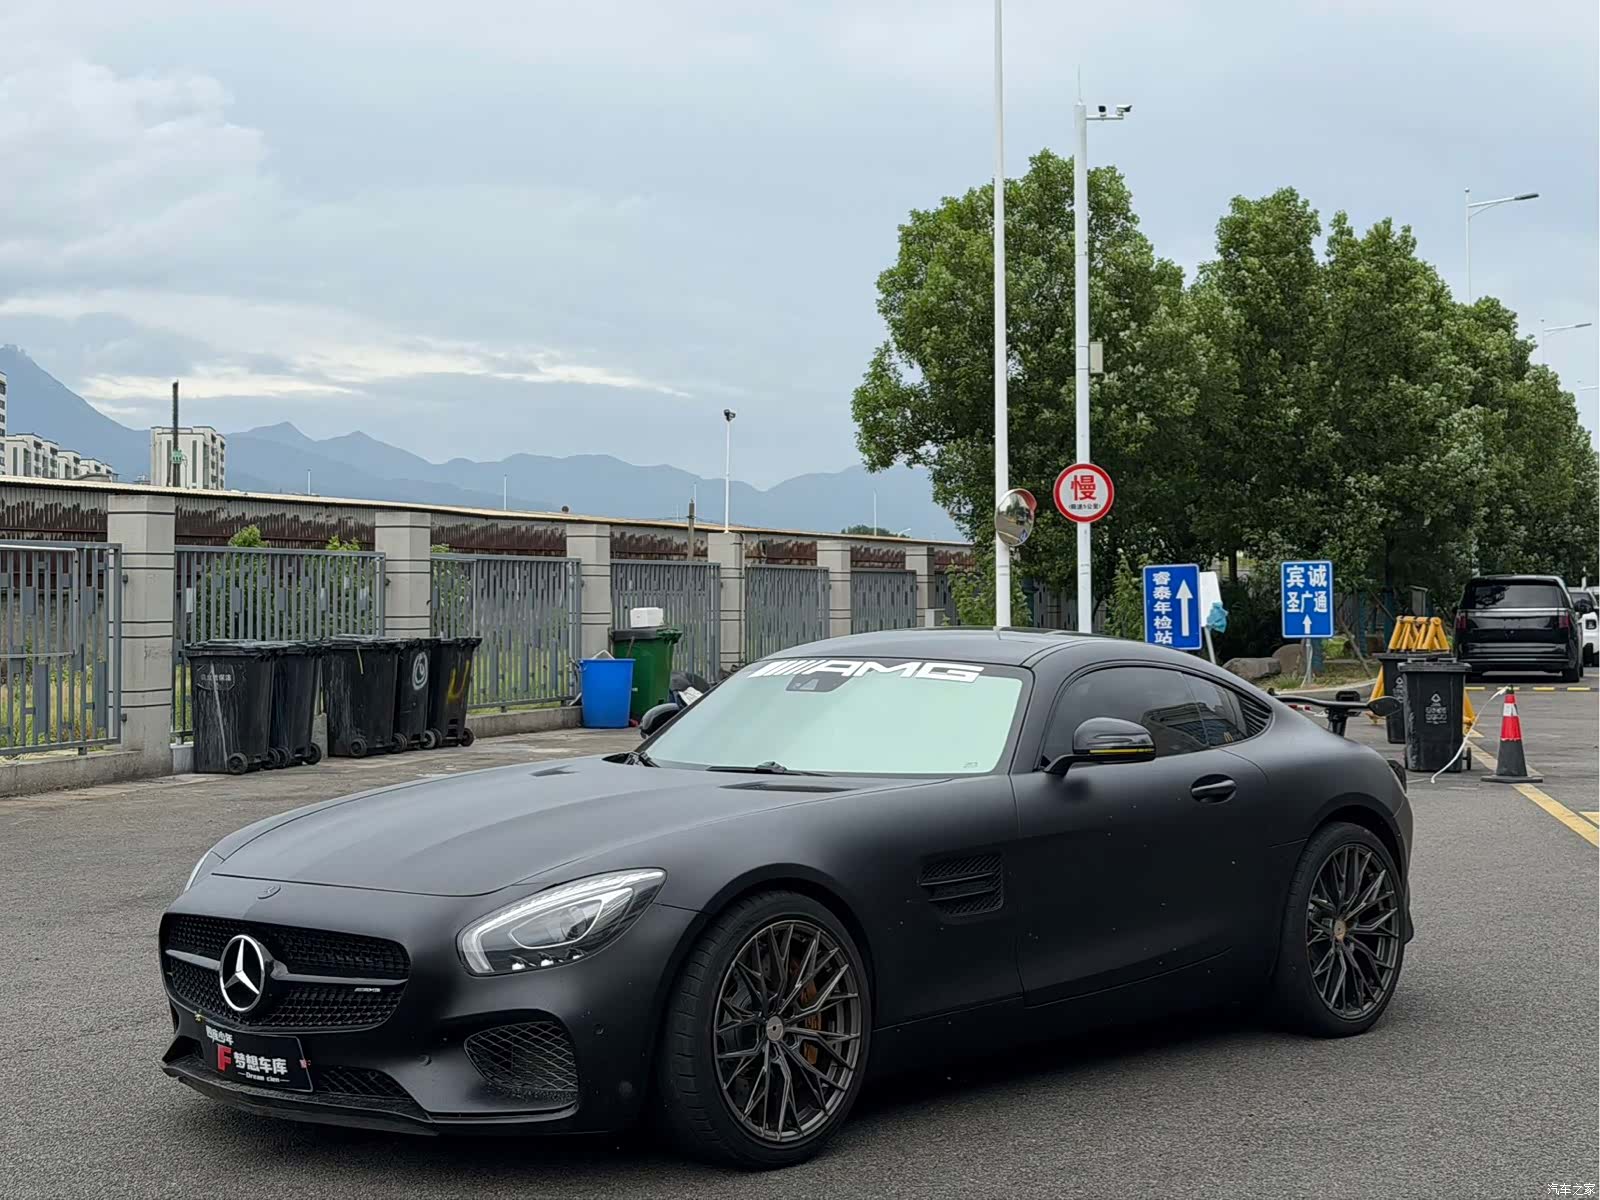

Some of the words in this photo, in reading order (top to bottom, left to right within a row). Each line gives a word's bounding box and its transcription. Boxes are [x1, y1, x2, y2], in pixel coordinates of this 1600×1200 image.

[1070, 475, 1097, 501] 慢
[1286, 564, 1327, 588] 宾诚
[1152, 571, 1173, 644] 睿泰年检站
[1286, 590, 1328, 613] 圣广通
[217, 1043, 232, 1072] F
[233, 1052, 288, 1075] 梦想车库
[245, 1071, 265, 1081] Dream
